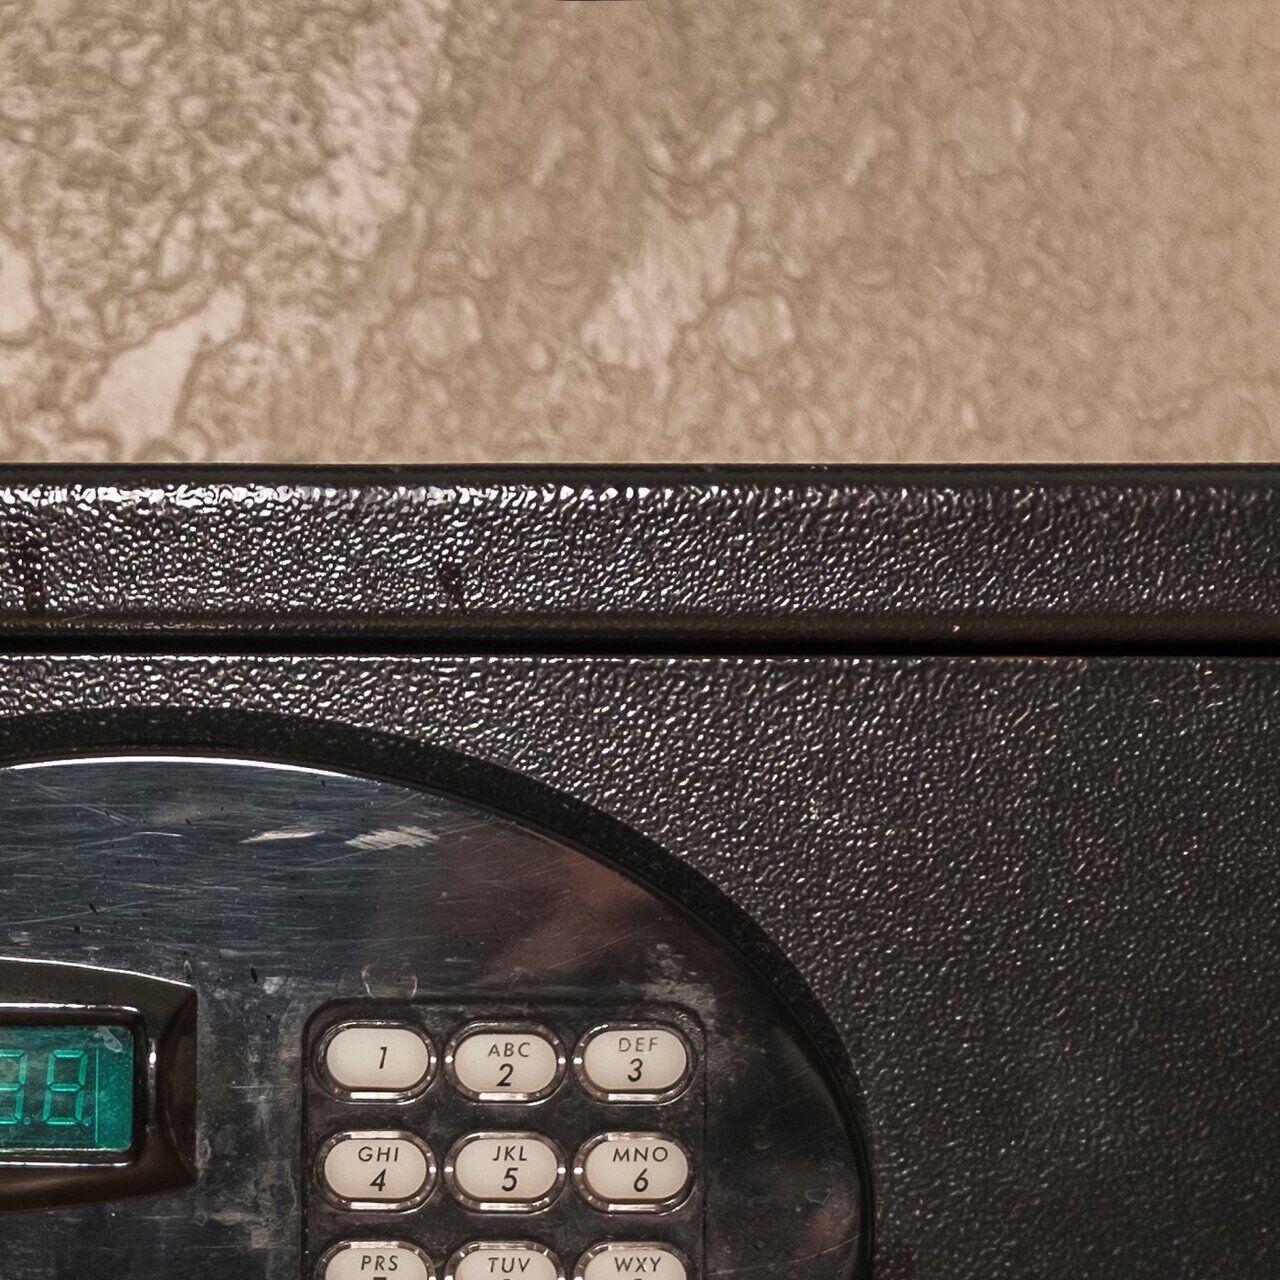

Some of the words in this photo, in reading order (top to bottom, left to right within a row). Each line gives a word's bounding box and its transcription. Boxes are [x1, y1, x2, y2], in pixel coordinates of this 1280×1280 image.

[487, 1041, 531, 1058] ABC
[618, 1036, 658, 1053] DEF
[378, 1046, 388, 1070] 1
[495, 1062, 514, 1088] 2
[626, 1057, 644, 1083] 3
[357, 1145, 400, 1163] GHI
[492, 1145, 528, 1162] JKL
[612, 1146, 669, 1163] MNO
[369, 1168, 387, 1193] 4
[500, 1166, 519, 1193] 5
[633, 1168, 650, 1193] 6
[360, 1254, 399, 1272] PRS
[487, 1256, 531, 1274] TUV
[613, 1256, 662, 1273] WXY
